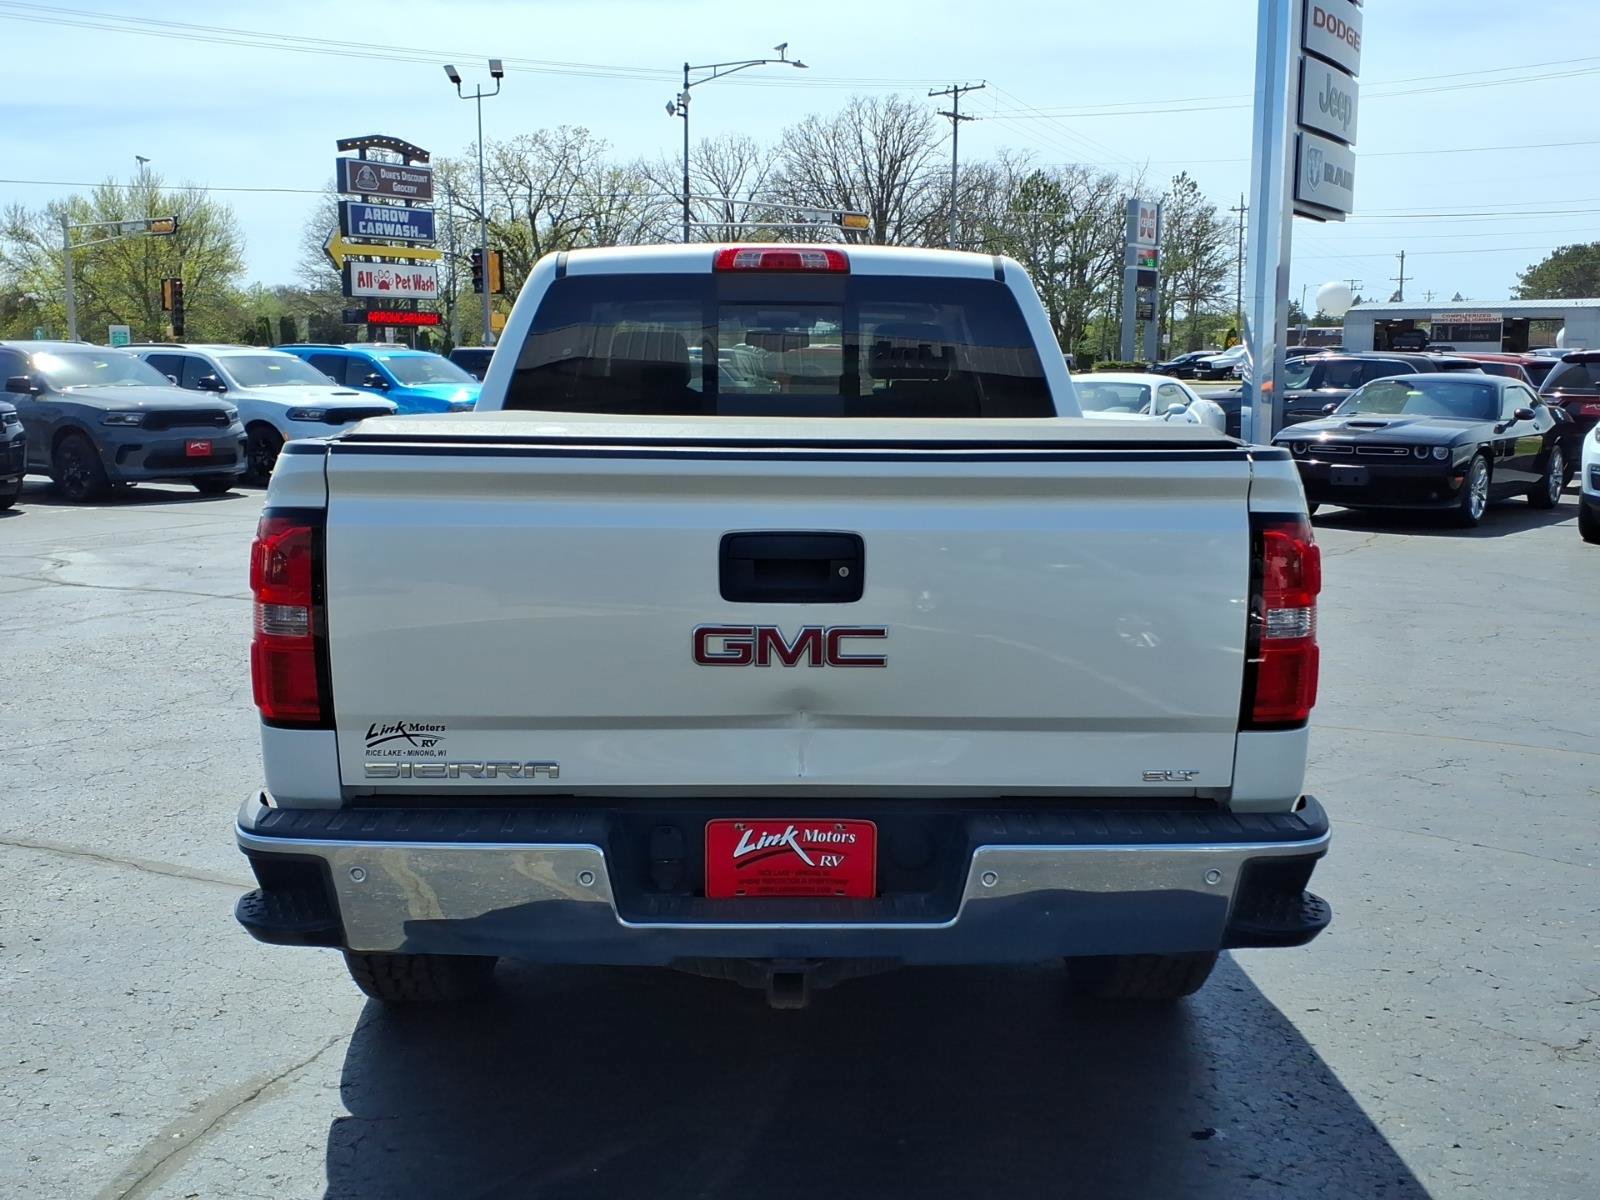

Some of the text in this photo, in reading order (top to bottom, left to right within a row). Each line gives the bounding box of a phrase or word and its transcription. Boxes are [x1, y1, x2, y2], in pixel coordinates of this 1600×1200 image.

[1313, 6, 1361, 52] DODGE
[1319, 73, 1353, 132] Jeep
[364, 207, 410, 223] ARROW
[357, 271, 435, 291] All Pet Wash
[692, 623, 888, 667] GMC
[365, 720, 446, 747] Link Motors
[421, 739, 438, 748] RV
[364, 761, 560, 779] SIERRA
[1142, 769, 1200, 782] SLT
[733, 825, 856, 867] Link Motors
[820, 855, 845, 867] RV
